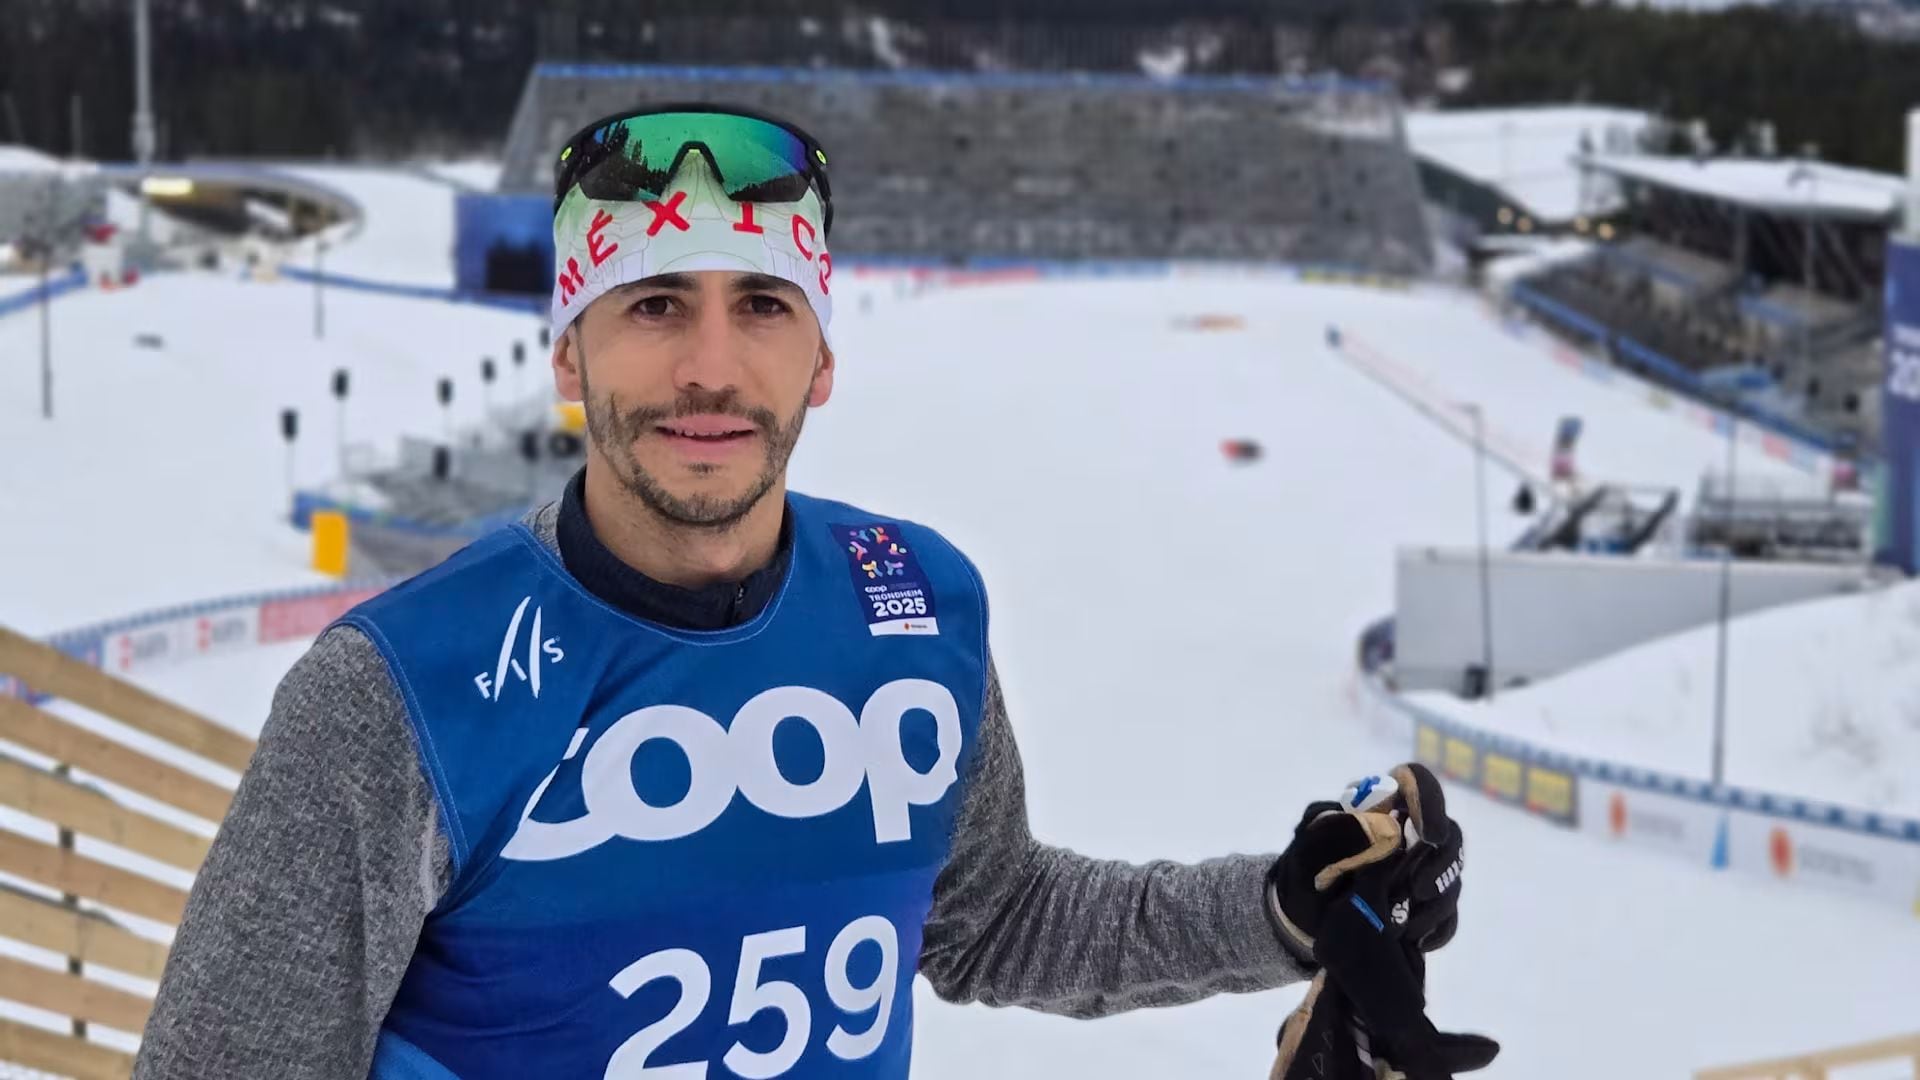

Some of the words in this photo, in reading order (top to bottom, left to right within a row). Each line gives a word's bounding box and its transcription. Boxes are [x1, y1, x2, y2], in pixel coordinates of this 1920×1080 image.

[868, 589, 924, 602] TRONDHEIM
[872, 597, 927, 617] 2025
[602, 915, 899, 1080] 259
